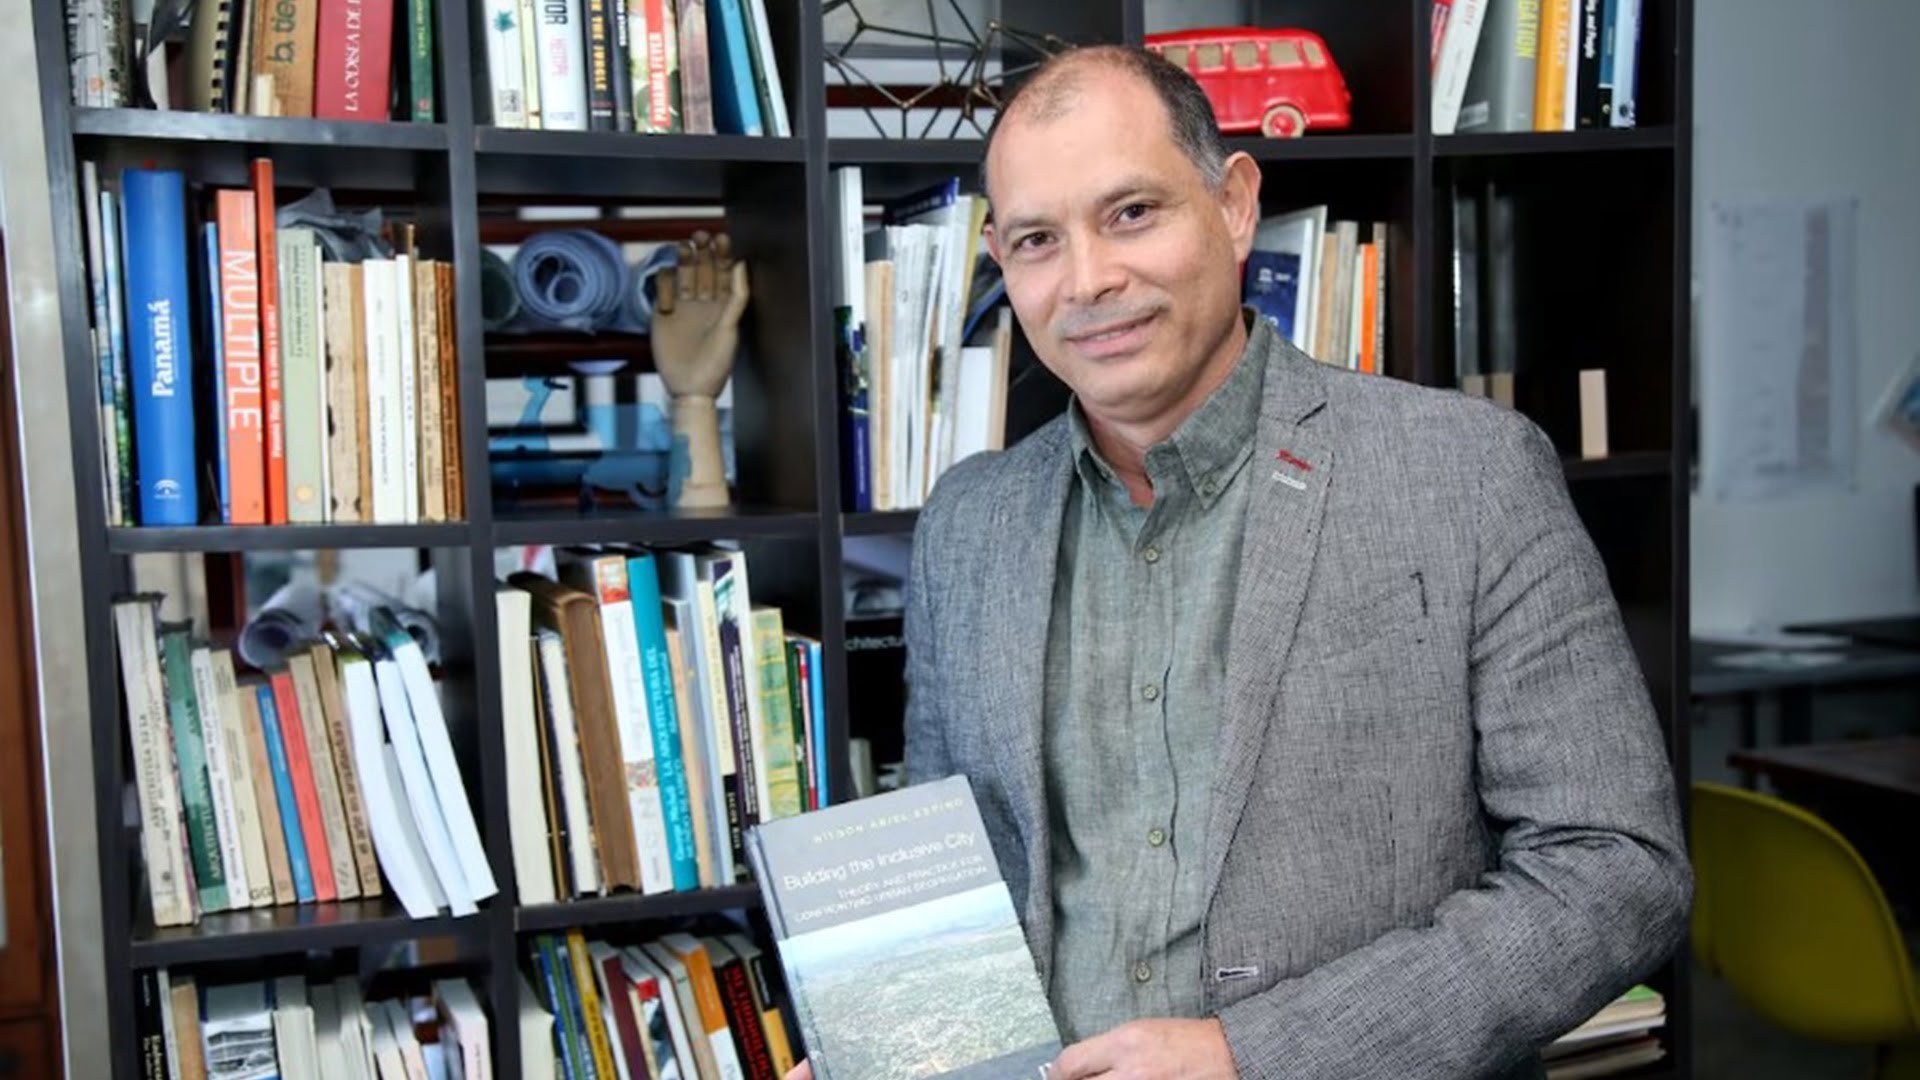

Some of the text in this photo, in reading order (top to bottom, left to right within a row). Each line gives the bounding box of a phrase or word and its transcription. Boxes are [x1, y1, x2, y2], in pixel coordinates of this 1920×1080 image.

[590, 45, 609, 91] JUNGLE
[651, 72, 667, 122] PANAMA
[344, 93, 358, 112] LA
[146, 300, 174, 397] Panamá
[224, 250, 261, 430] MULTIPLE
[648, 673, 672, 759] ARQUITECTURA
[784, 830, 976, 892] Building the Inclusive City
